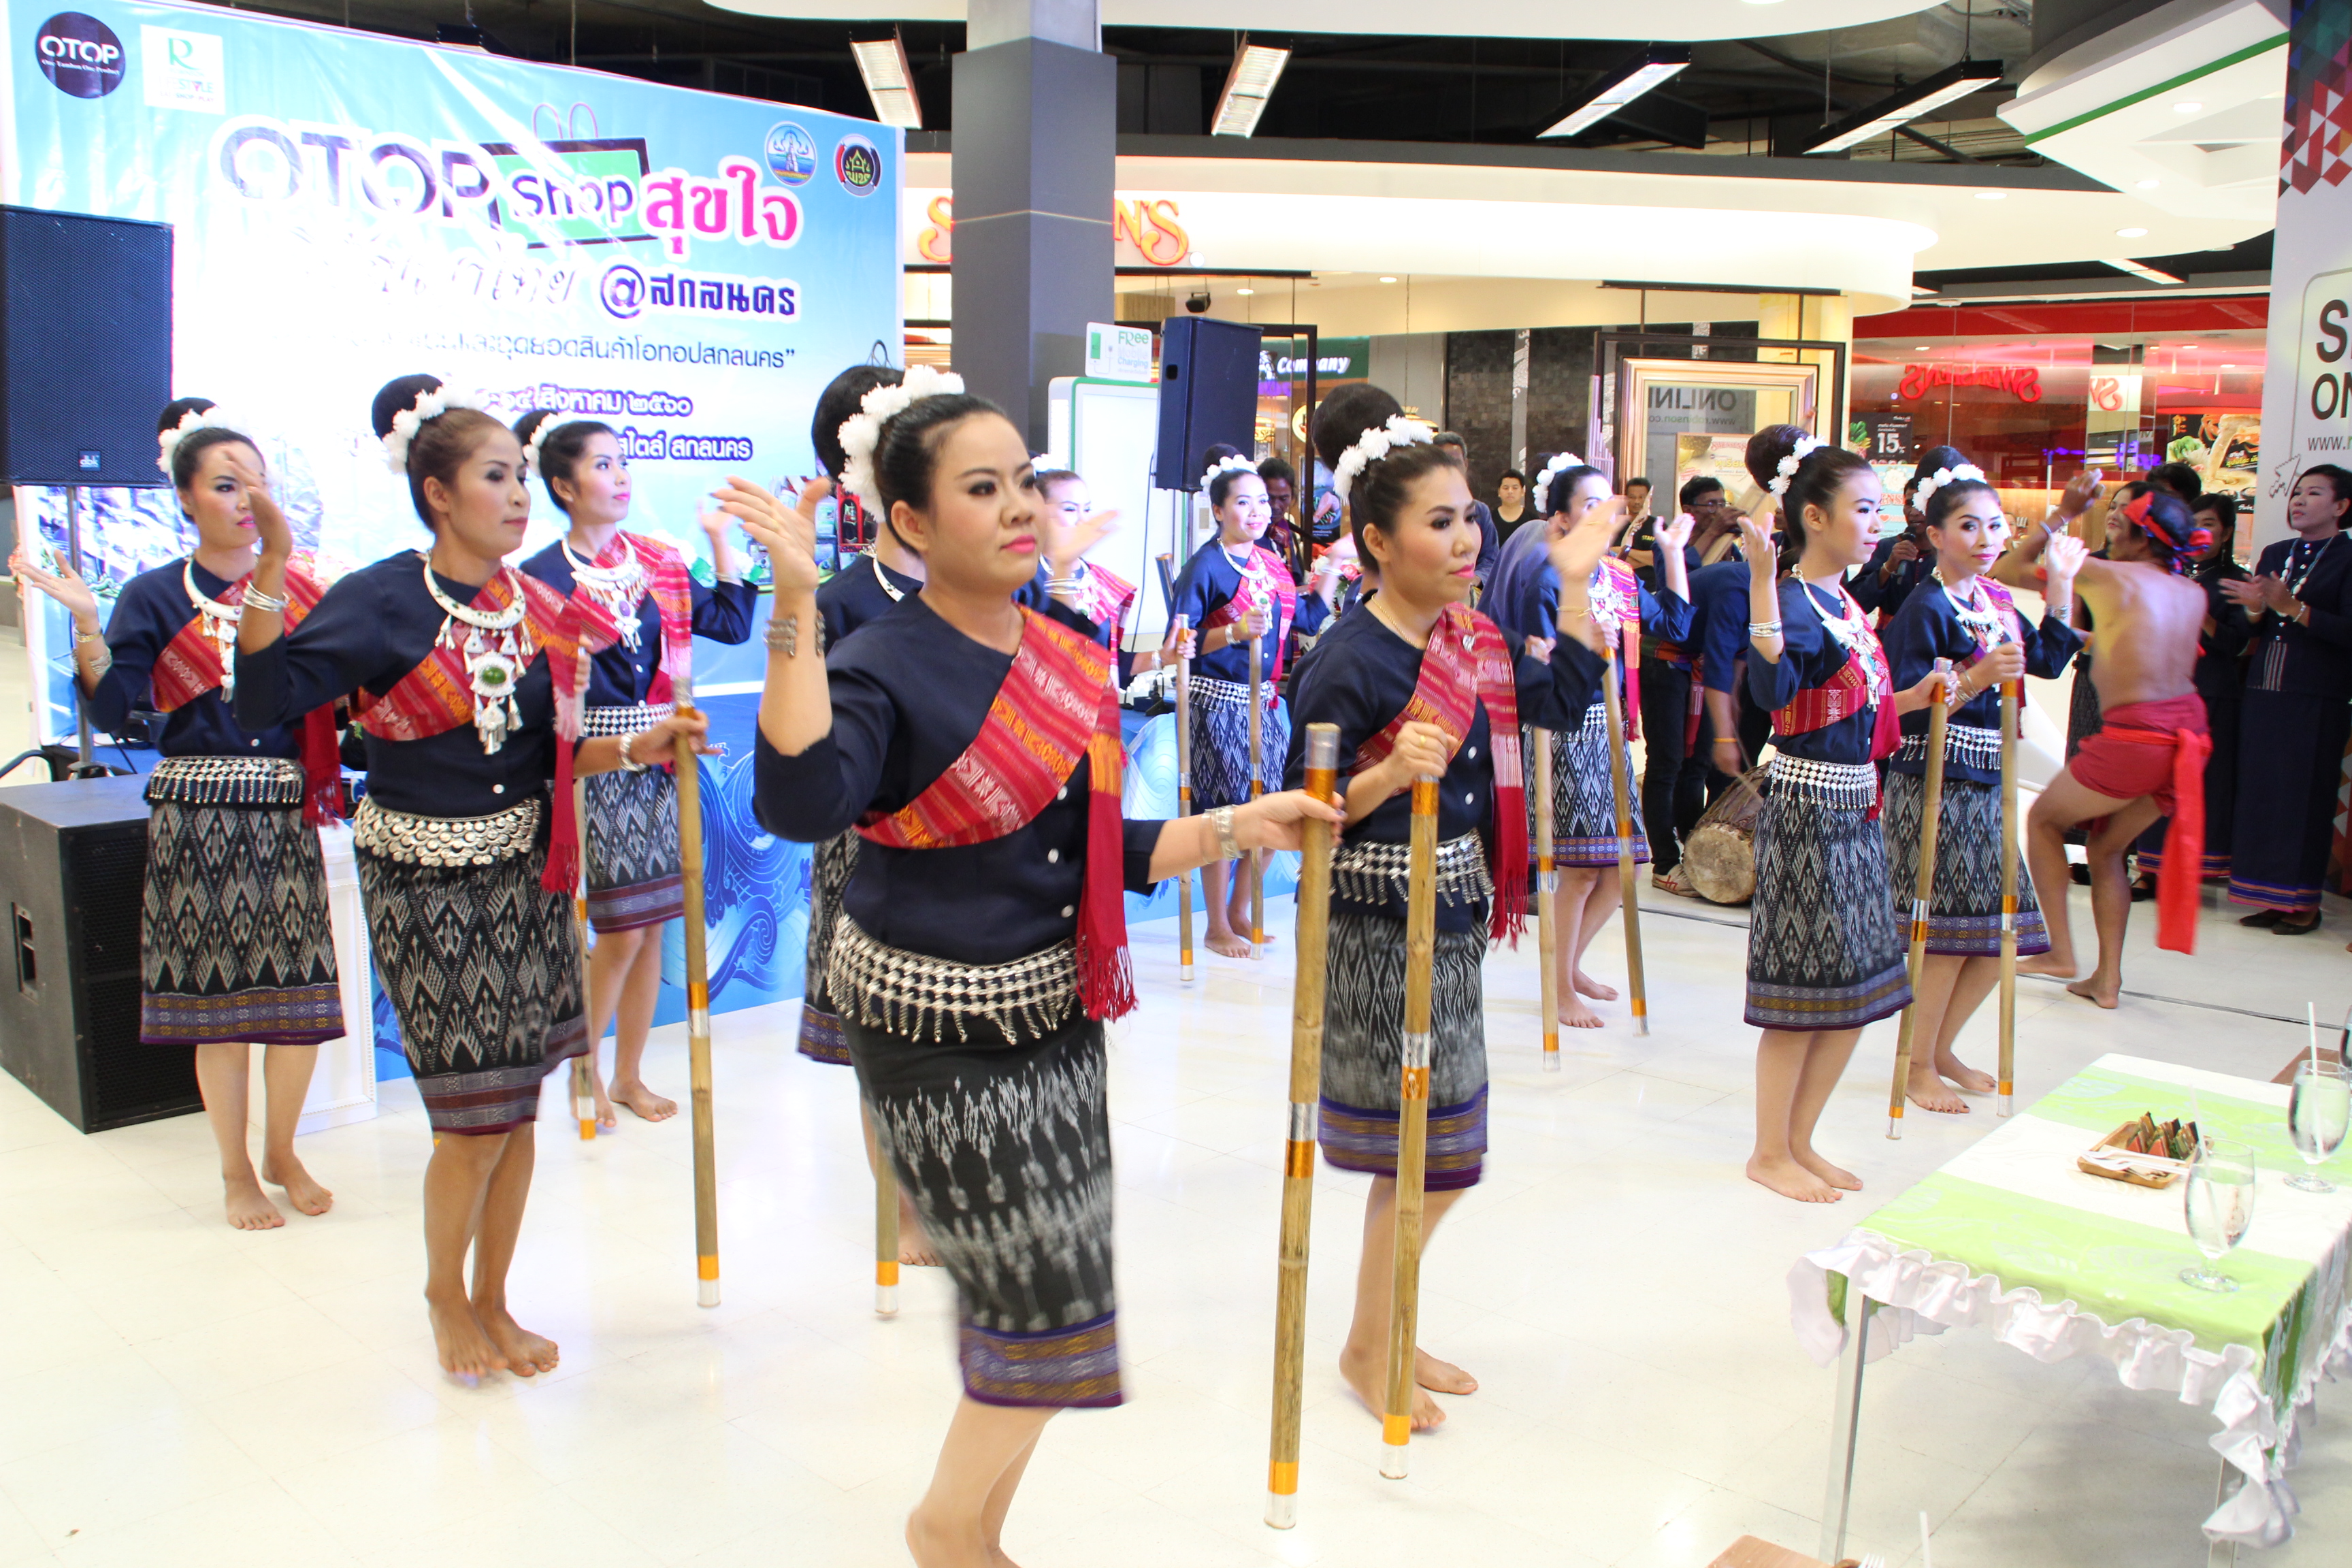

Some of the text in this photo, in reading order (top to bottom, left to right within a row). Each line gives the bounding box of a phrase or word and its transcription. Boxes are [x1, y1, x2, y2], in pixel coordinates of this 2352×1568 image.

[39, 35, 120, 64] OTOP
[219, 126, 491, 218] OTOP
[645, 165, 798, 255] สุขใจ
[1277, 356, 1351, 374] Comany
[670, 436, 753, 460] สกลนคร
